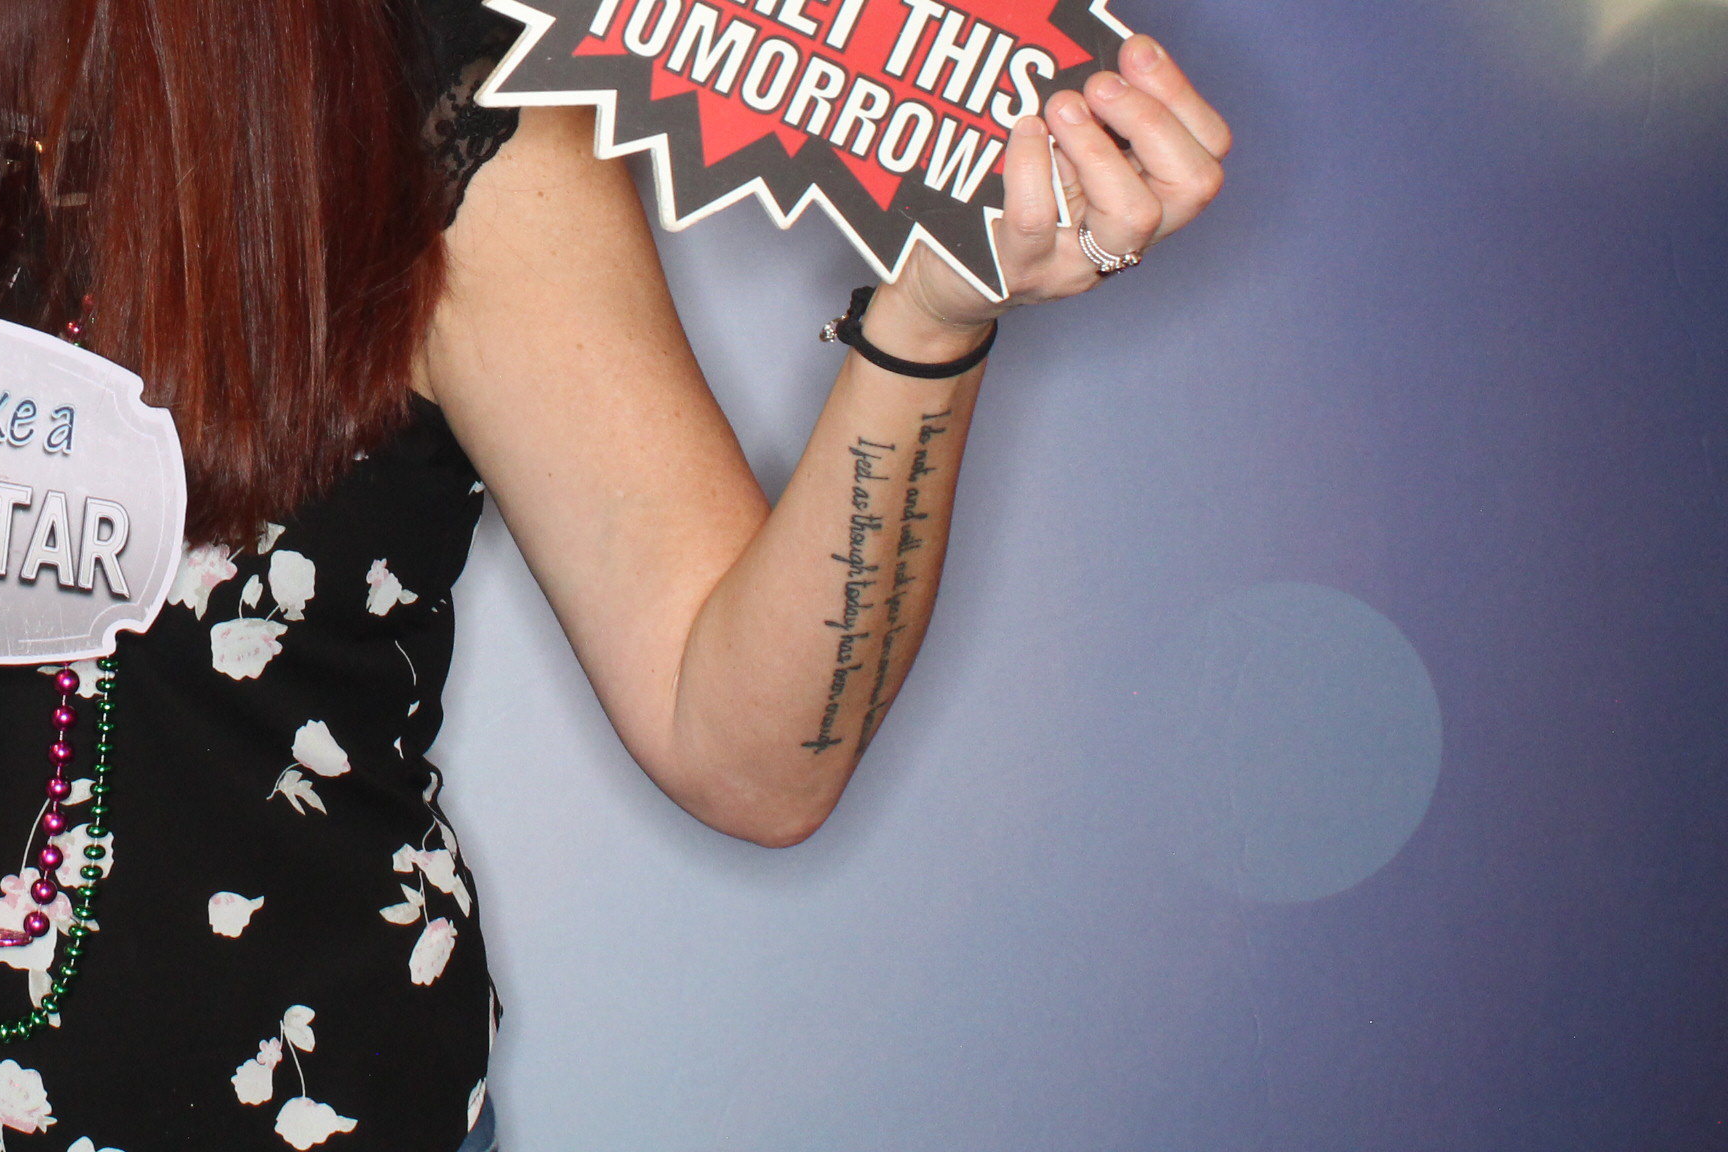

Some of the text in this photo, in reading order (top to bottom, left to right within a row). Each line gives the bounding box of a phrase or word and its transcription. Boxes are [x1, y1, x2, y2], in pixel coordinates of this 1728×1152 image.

[42, 401, 78, 456] a
[857, 436, 896, 451] I
[848, 445, 890, 483] feel
[851, 485, 870, 513] as
[900, 488, 929, 521] and
[830, 513, 884, 578] though
[823, 579, 877, 632] today
[836, 632, 870, 664] has
